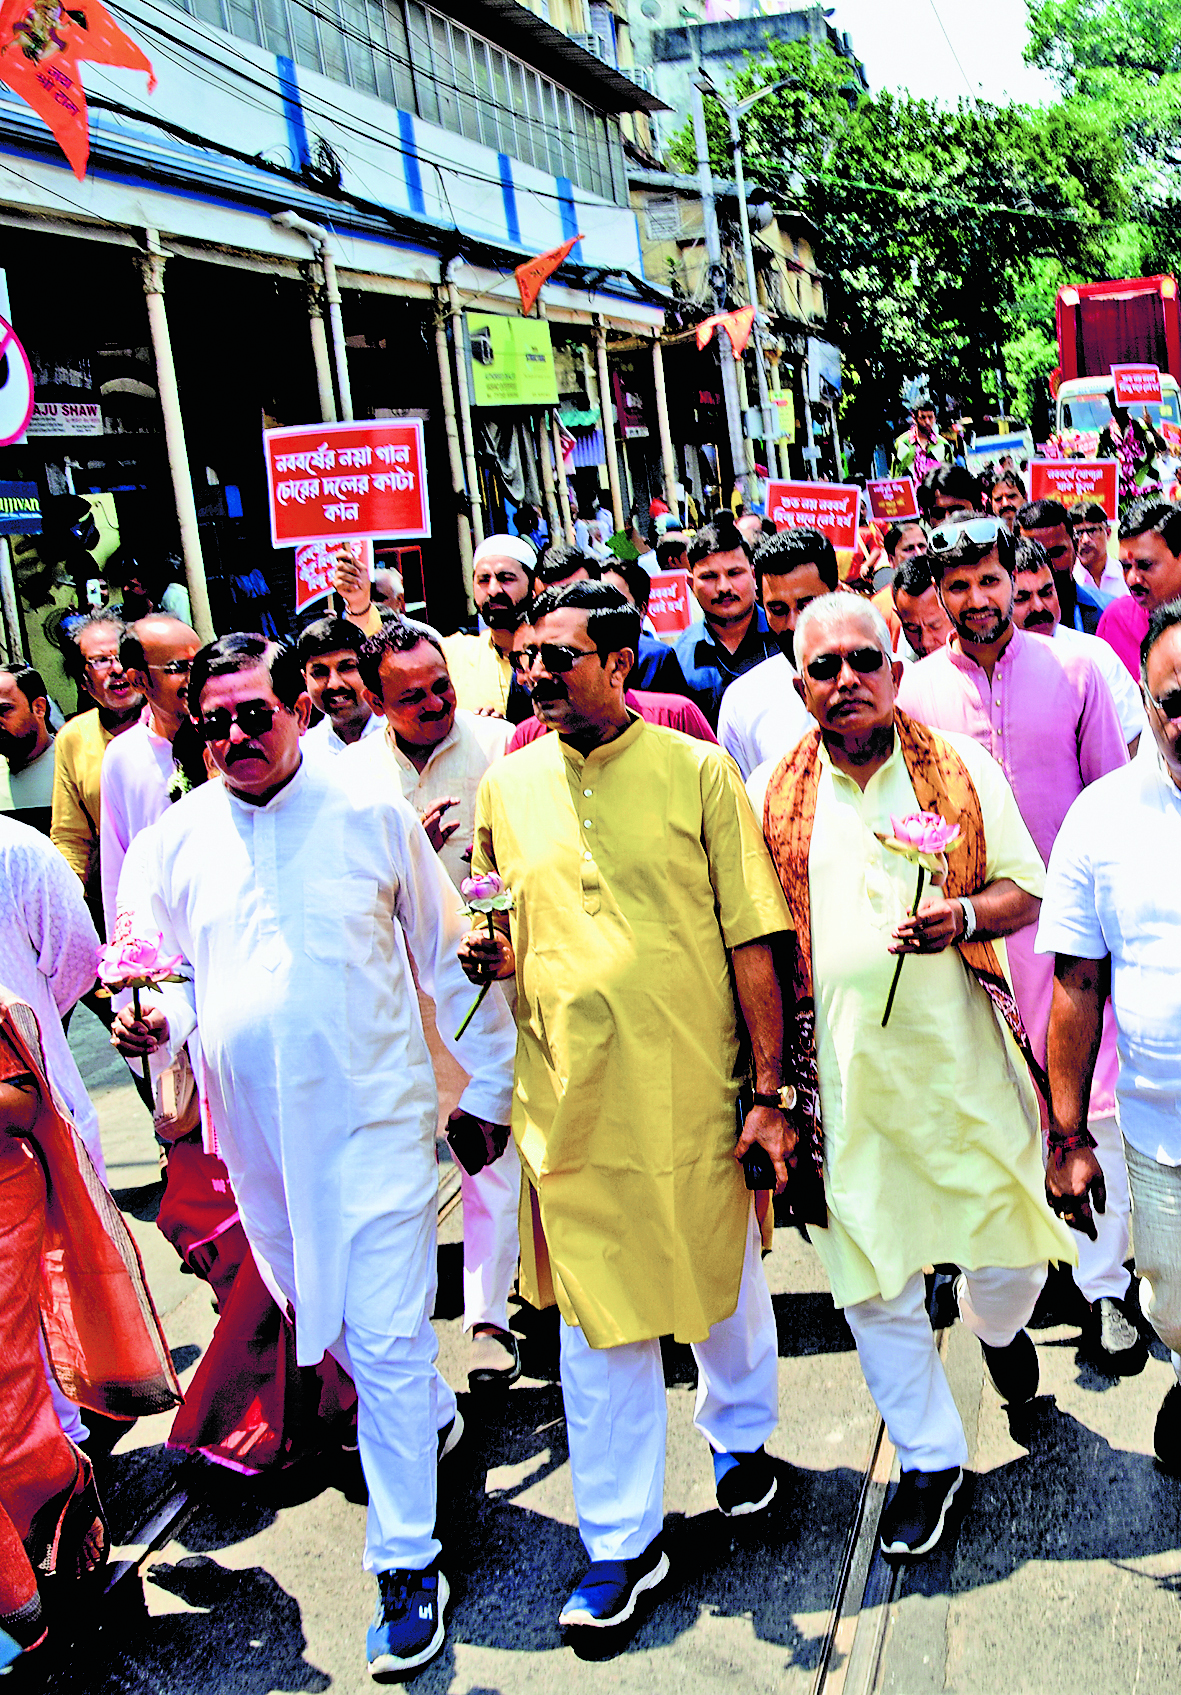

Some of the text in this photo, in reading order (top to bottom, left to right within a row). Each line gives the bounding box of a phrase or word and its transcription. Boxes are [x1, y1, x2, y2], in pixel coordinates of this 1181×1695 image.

[34, 404, 97, 417] AJU SHAW
[274, 442, 411, 476] নববর্ষের নয়া গান
[276, 465, 416, 506] চোরের দলের কাটা
[322, 501, 360, 522] কান
